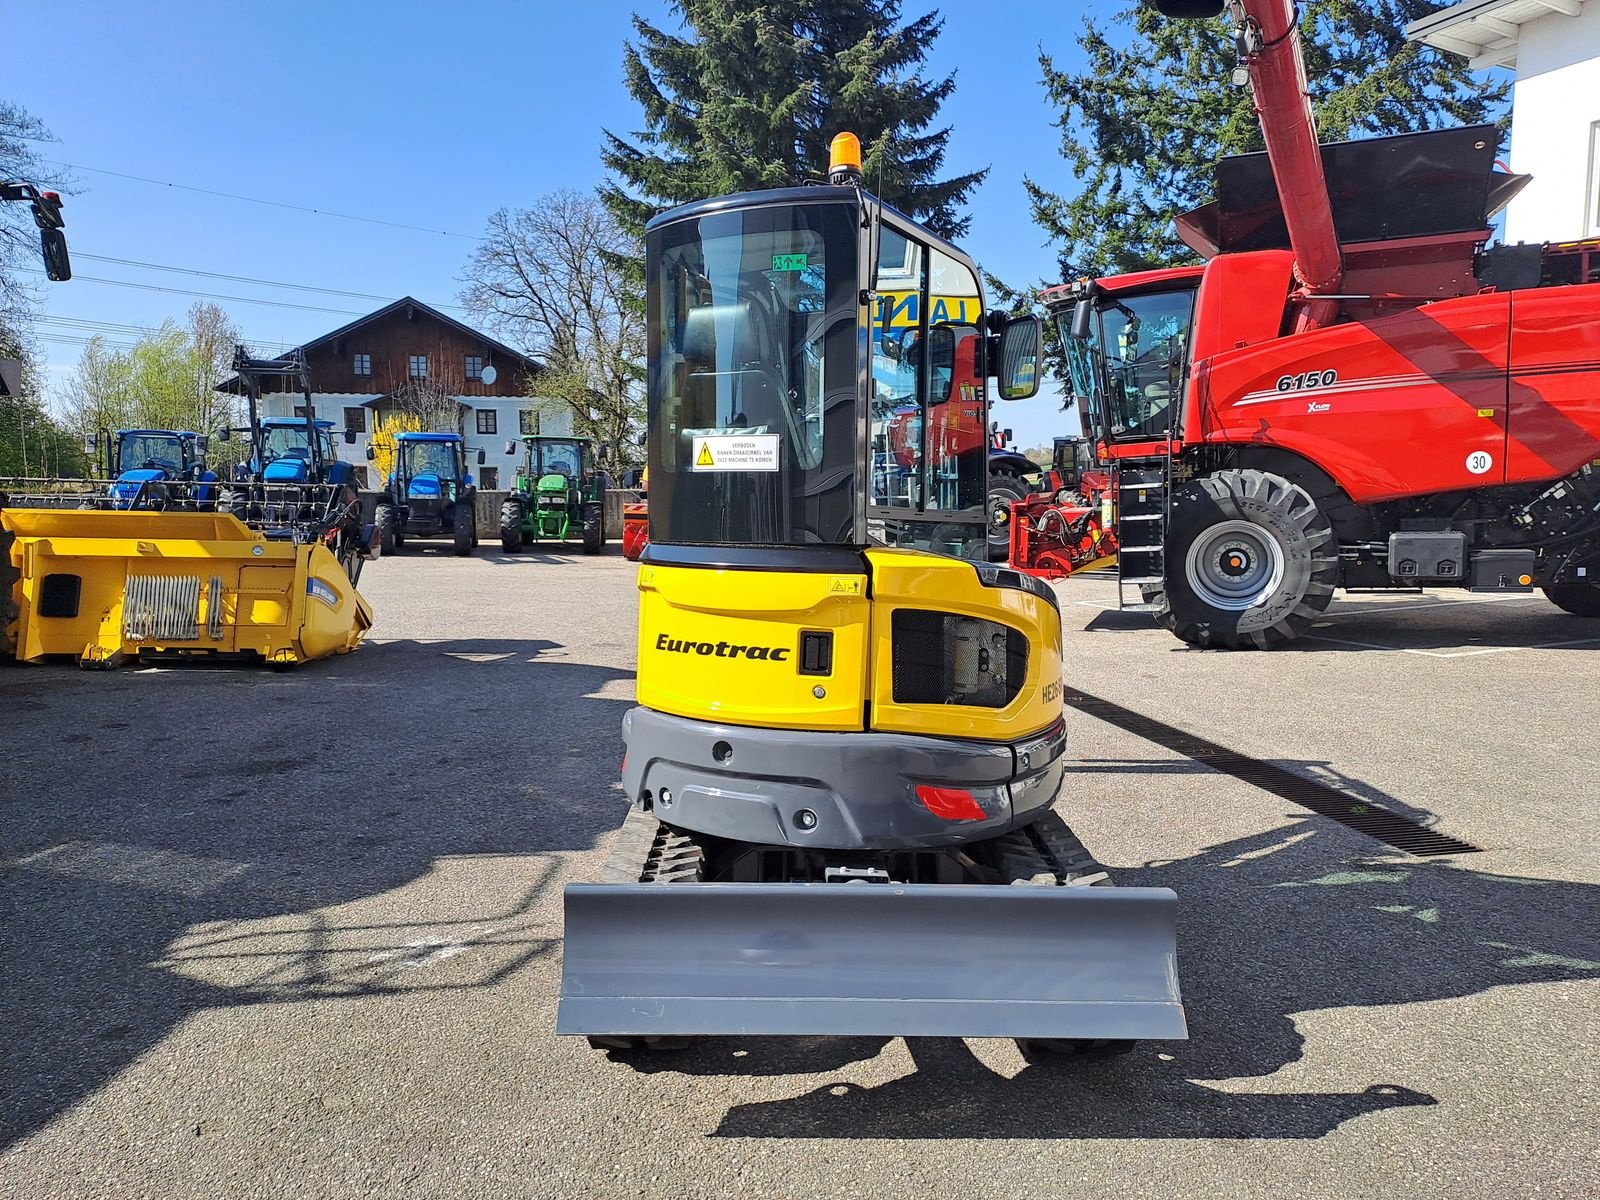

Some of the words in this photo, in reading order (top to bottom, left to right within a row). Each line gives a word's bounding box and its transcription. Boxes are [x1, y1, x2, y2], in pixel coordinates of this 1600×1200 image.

[1277, 369, 1337, 392] 6150
[1472, 455, 1486, 470] 30
[655, 633, 791, 662] Eurotrac
